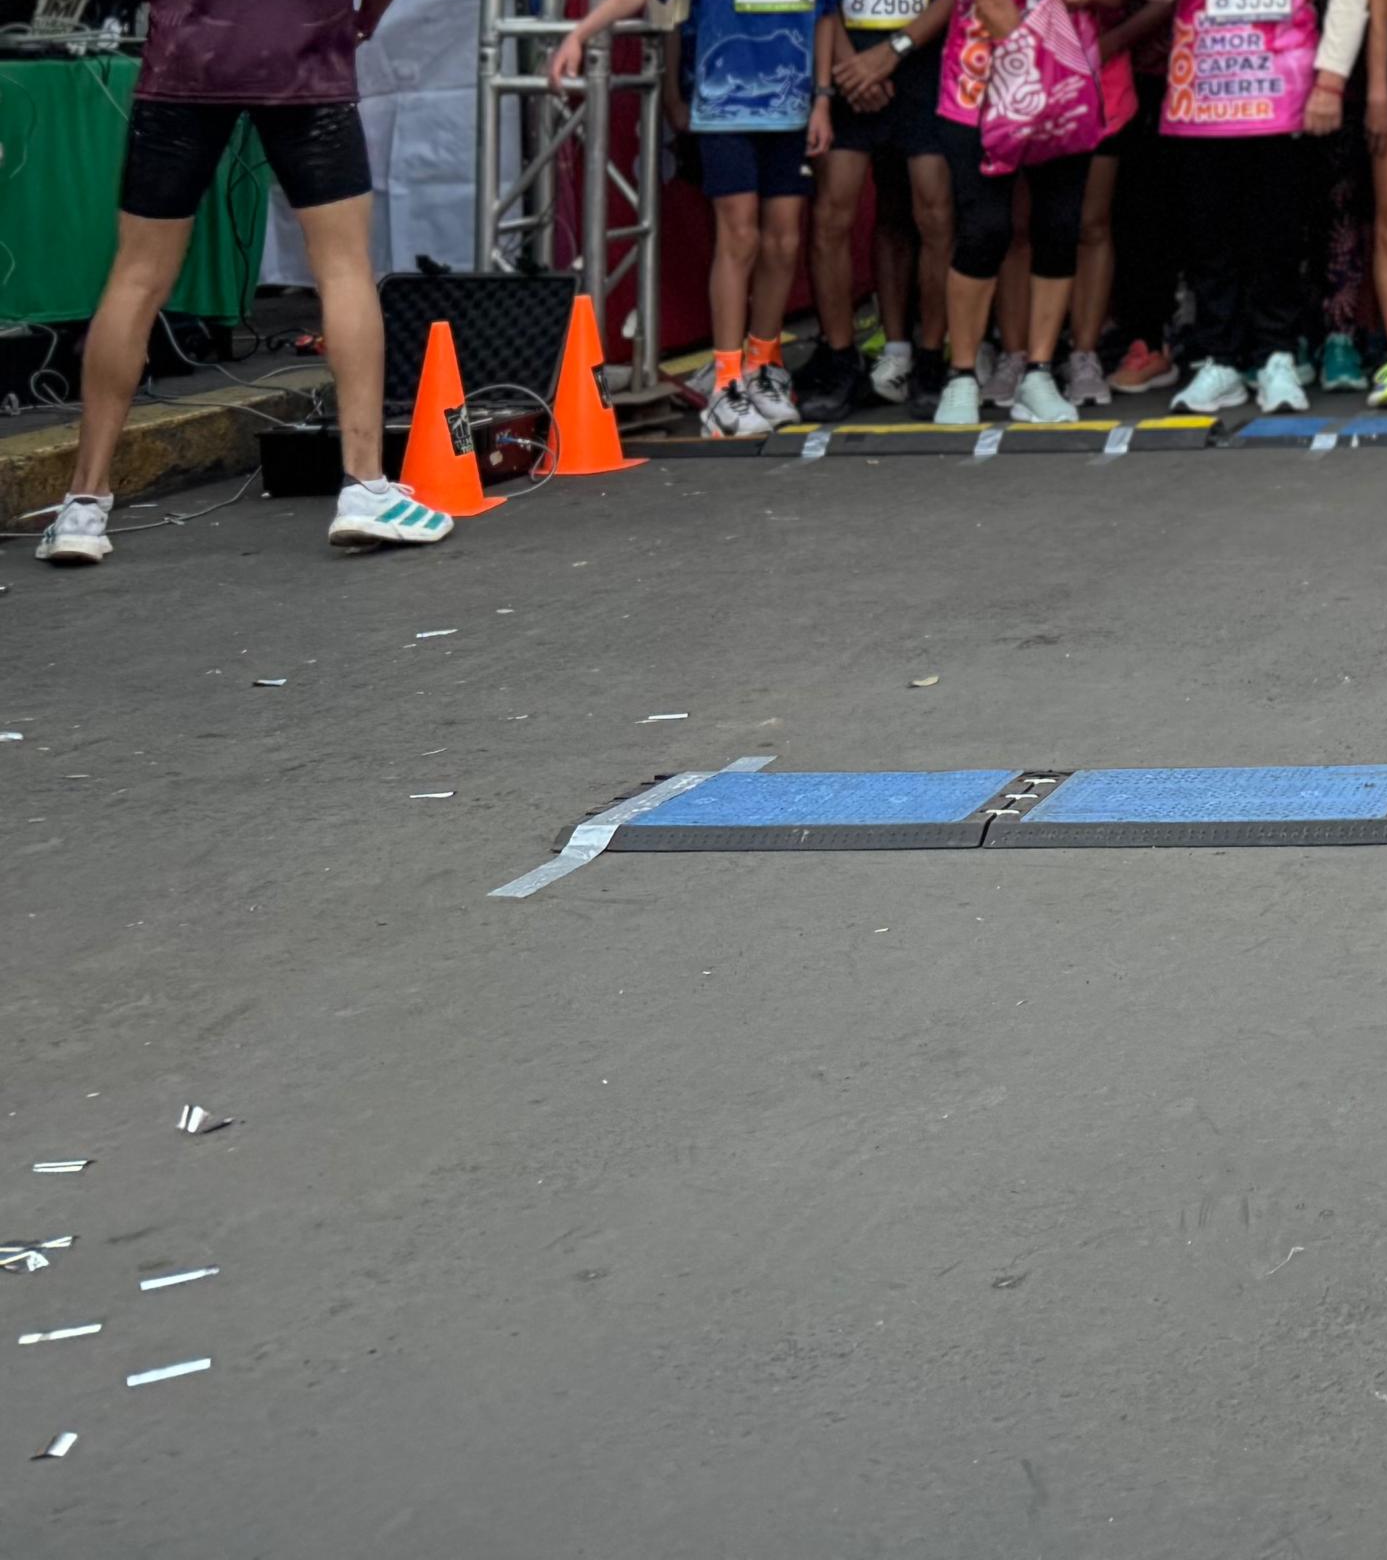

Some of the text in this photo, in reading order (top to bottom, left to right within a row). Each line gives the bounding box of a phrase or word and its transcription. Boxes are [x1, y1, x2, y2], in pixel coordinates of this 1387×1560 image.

[1195, 32, 1263, 51] AMOR
[1196, 54, 1271, 75] CAPAZ
[1196, 77, 1283, 97] FUERTE
[1195, 101, 1271, 120] MUJER
